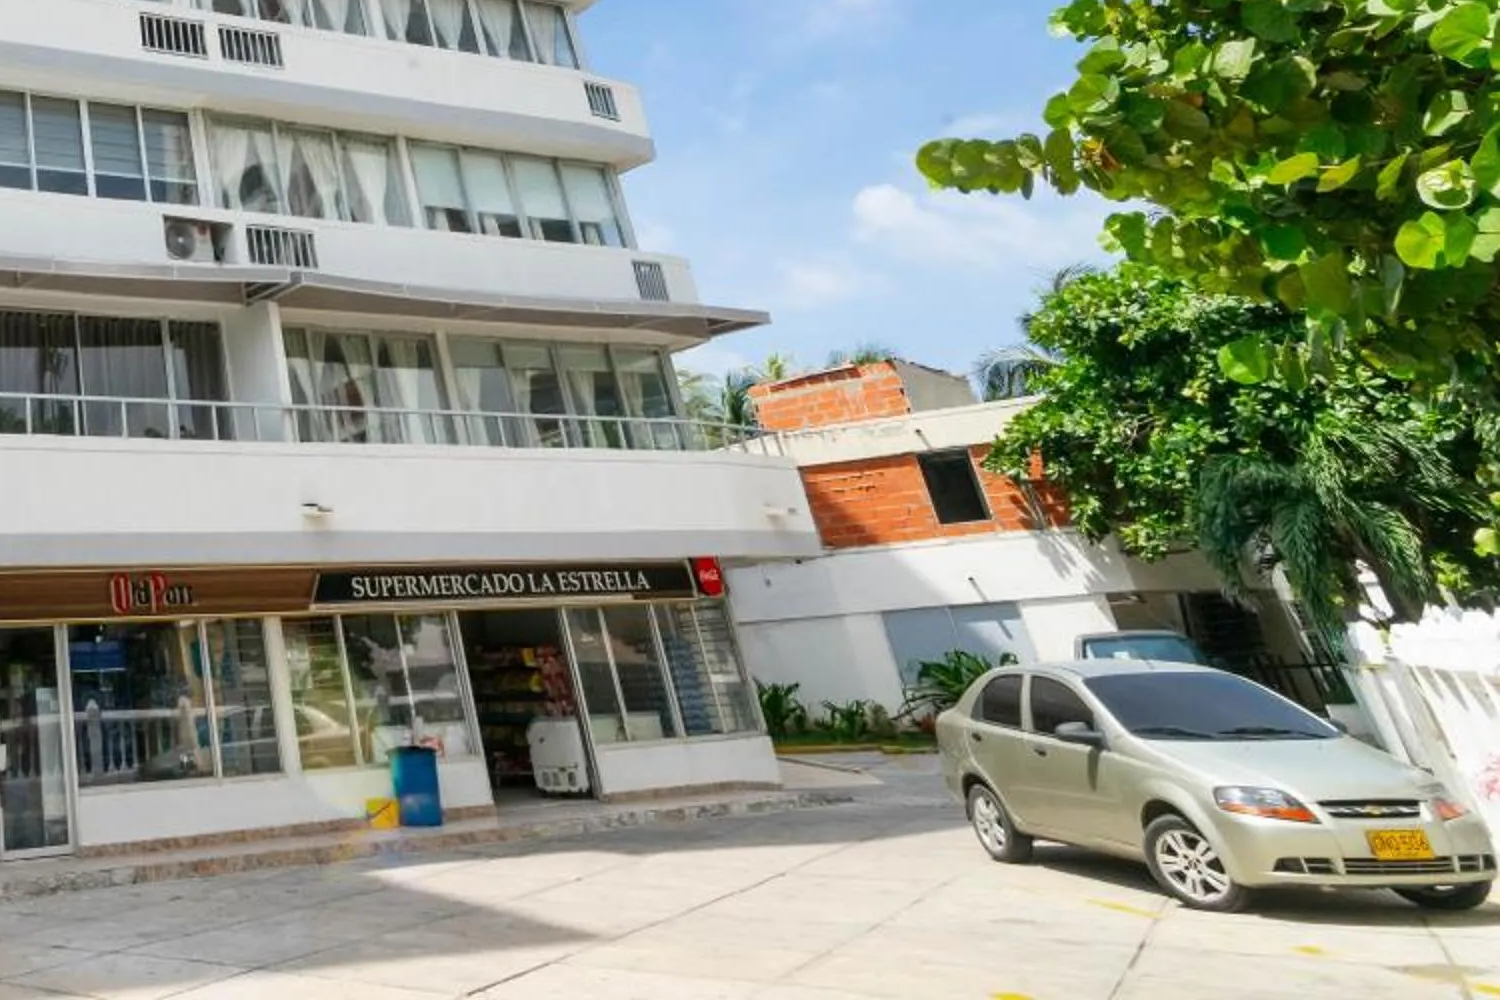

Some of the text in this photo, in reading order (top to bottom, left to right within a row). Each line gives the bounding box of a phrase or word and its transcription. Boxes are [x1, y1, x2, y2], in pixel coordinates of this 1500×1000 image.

[351, 570, 651, 598] SUPERMERCADO LA ESTRELLA
